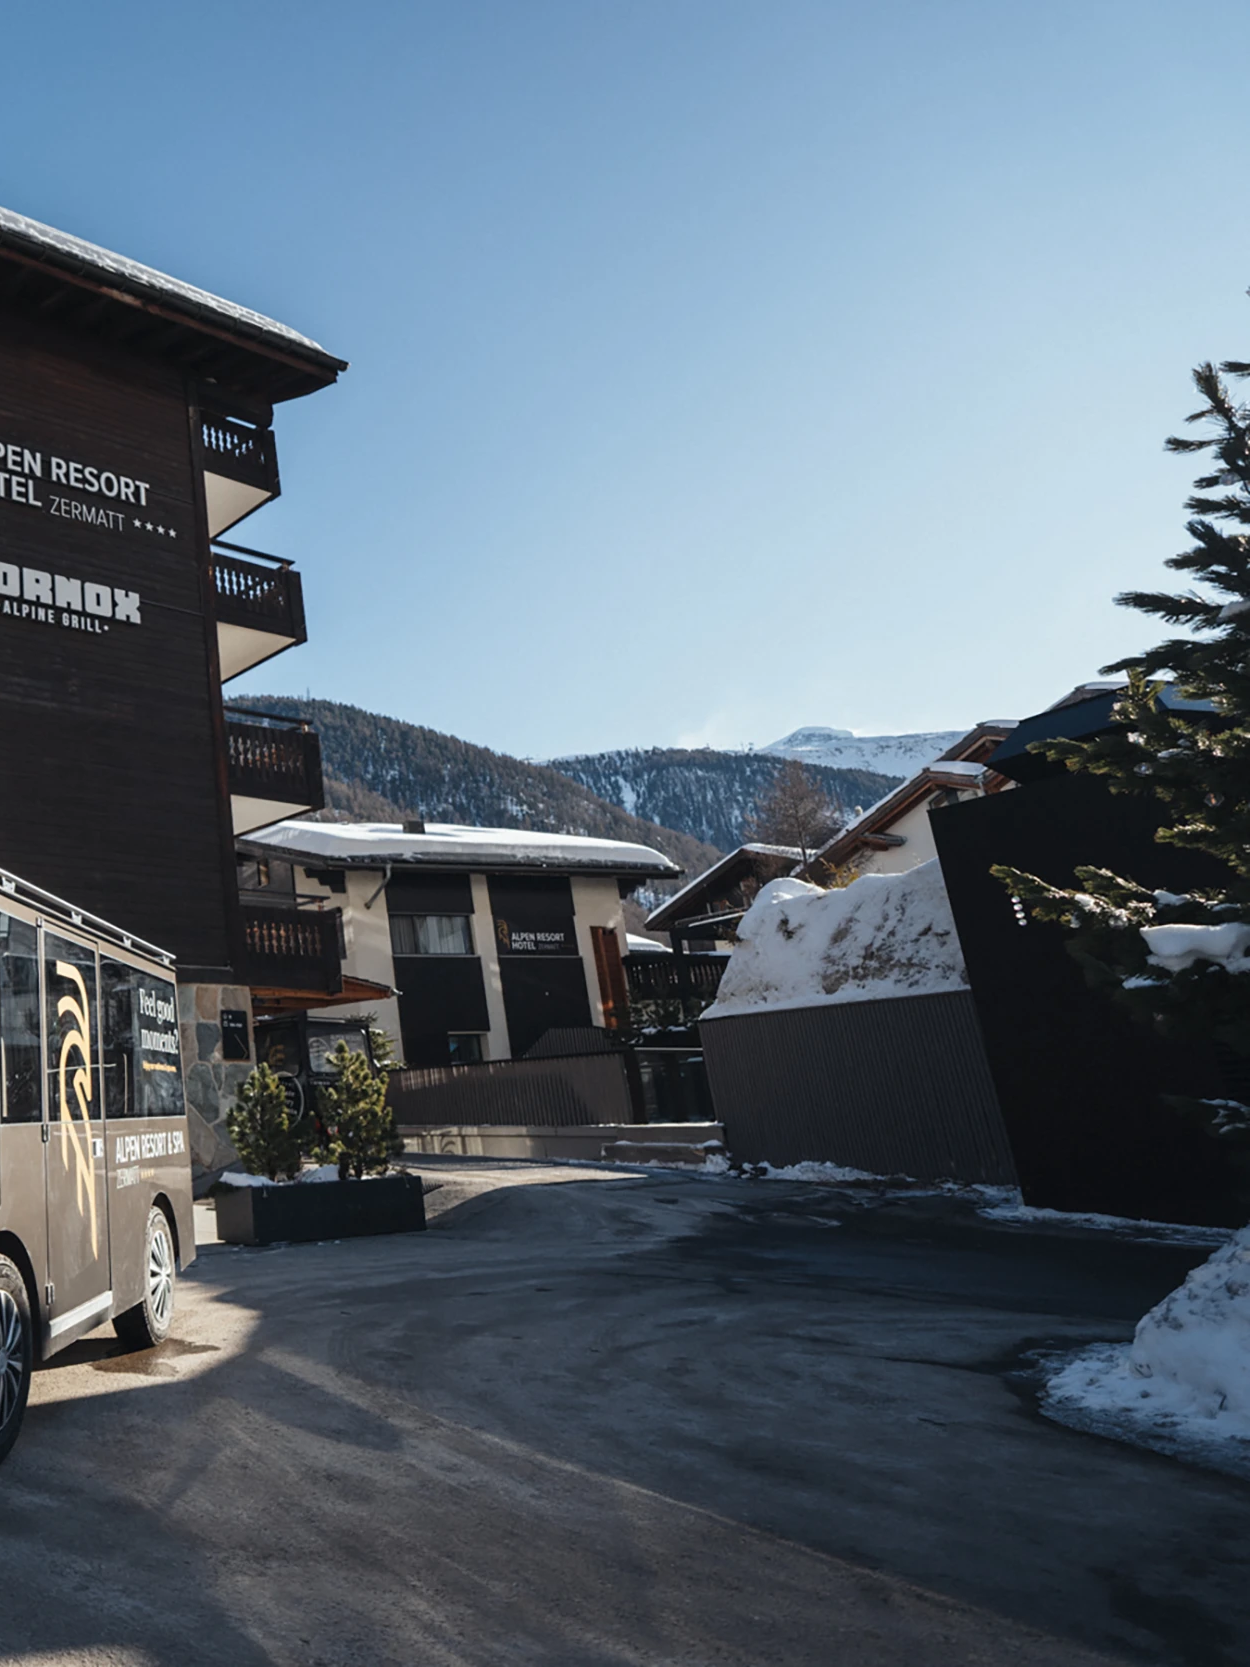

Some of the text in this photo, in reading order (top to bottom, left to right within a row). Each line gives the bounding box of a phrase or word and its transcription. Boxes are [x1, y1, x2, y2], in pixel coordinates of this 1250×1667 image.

[50, 456, 150, 506] RESORT
[49, 495, 126, 532] ZERMATT
[2, 600, 103, 634] ALPINE GRILL
[511, 932, 565, 942] ALPEN RESORT
[511, 941, 537, 950] HOTEL
[139, 988, 175, 1025] Feel good
[140, 1028, 179, 1055] moments?
[115, 1134, 140, 1164] ALPEN
[141, 1131, 166, 1160] RESORT
[172, 1130, 186, 1154] SPA
